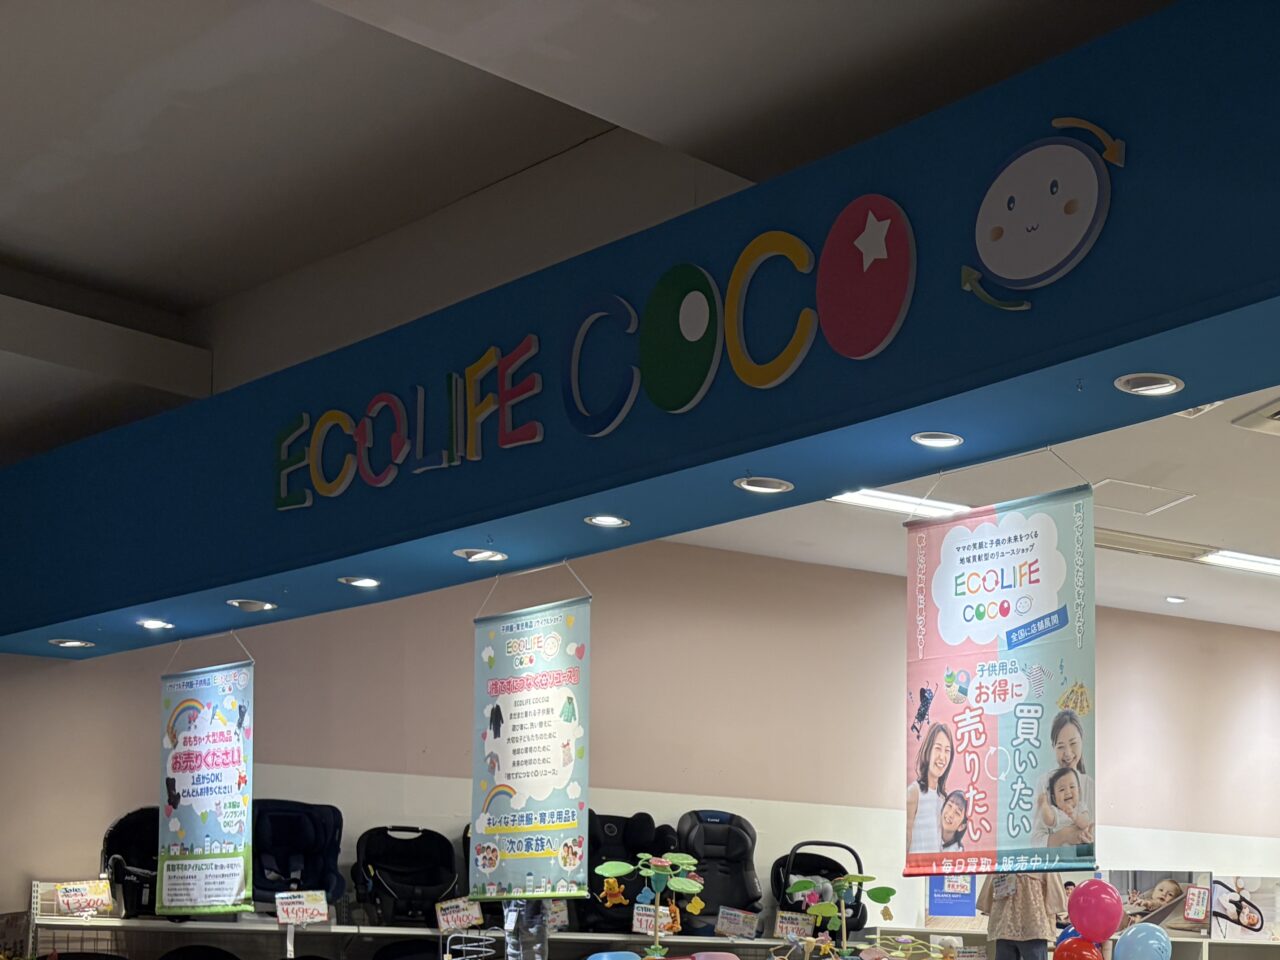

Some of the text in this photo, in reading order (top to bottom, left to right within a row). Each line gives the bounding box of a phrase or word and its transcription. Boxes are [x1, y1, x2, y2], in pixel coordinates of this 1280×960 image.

[275, 193, 917, 511] ECOLIFE COCO
[954, 558, 1041, 597] ECOLIFE
[963, 600, 1011, 623] COCO
[1010, 613, 1060, 643] 全国に店舗展開
[976, 660, 1019, 677] 子供用品
[974, 679, 1023, 704] お得に
[953, 706, 992, 841] 売りたい
[1007, 703, 1044, 838] 買いたい
